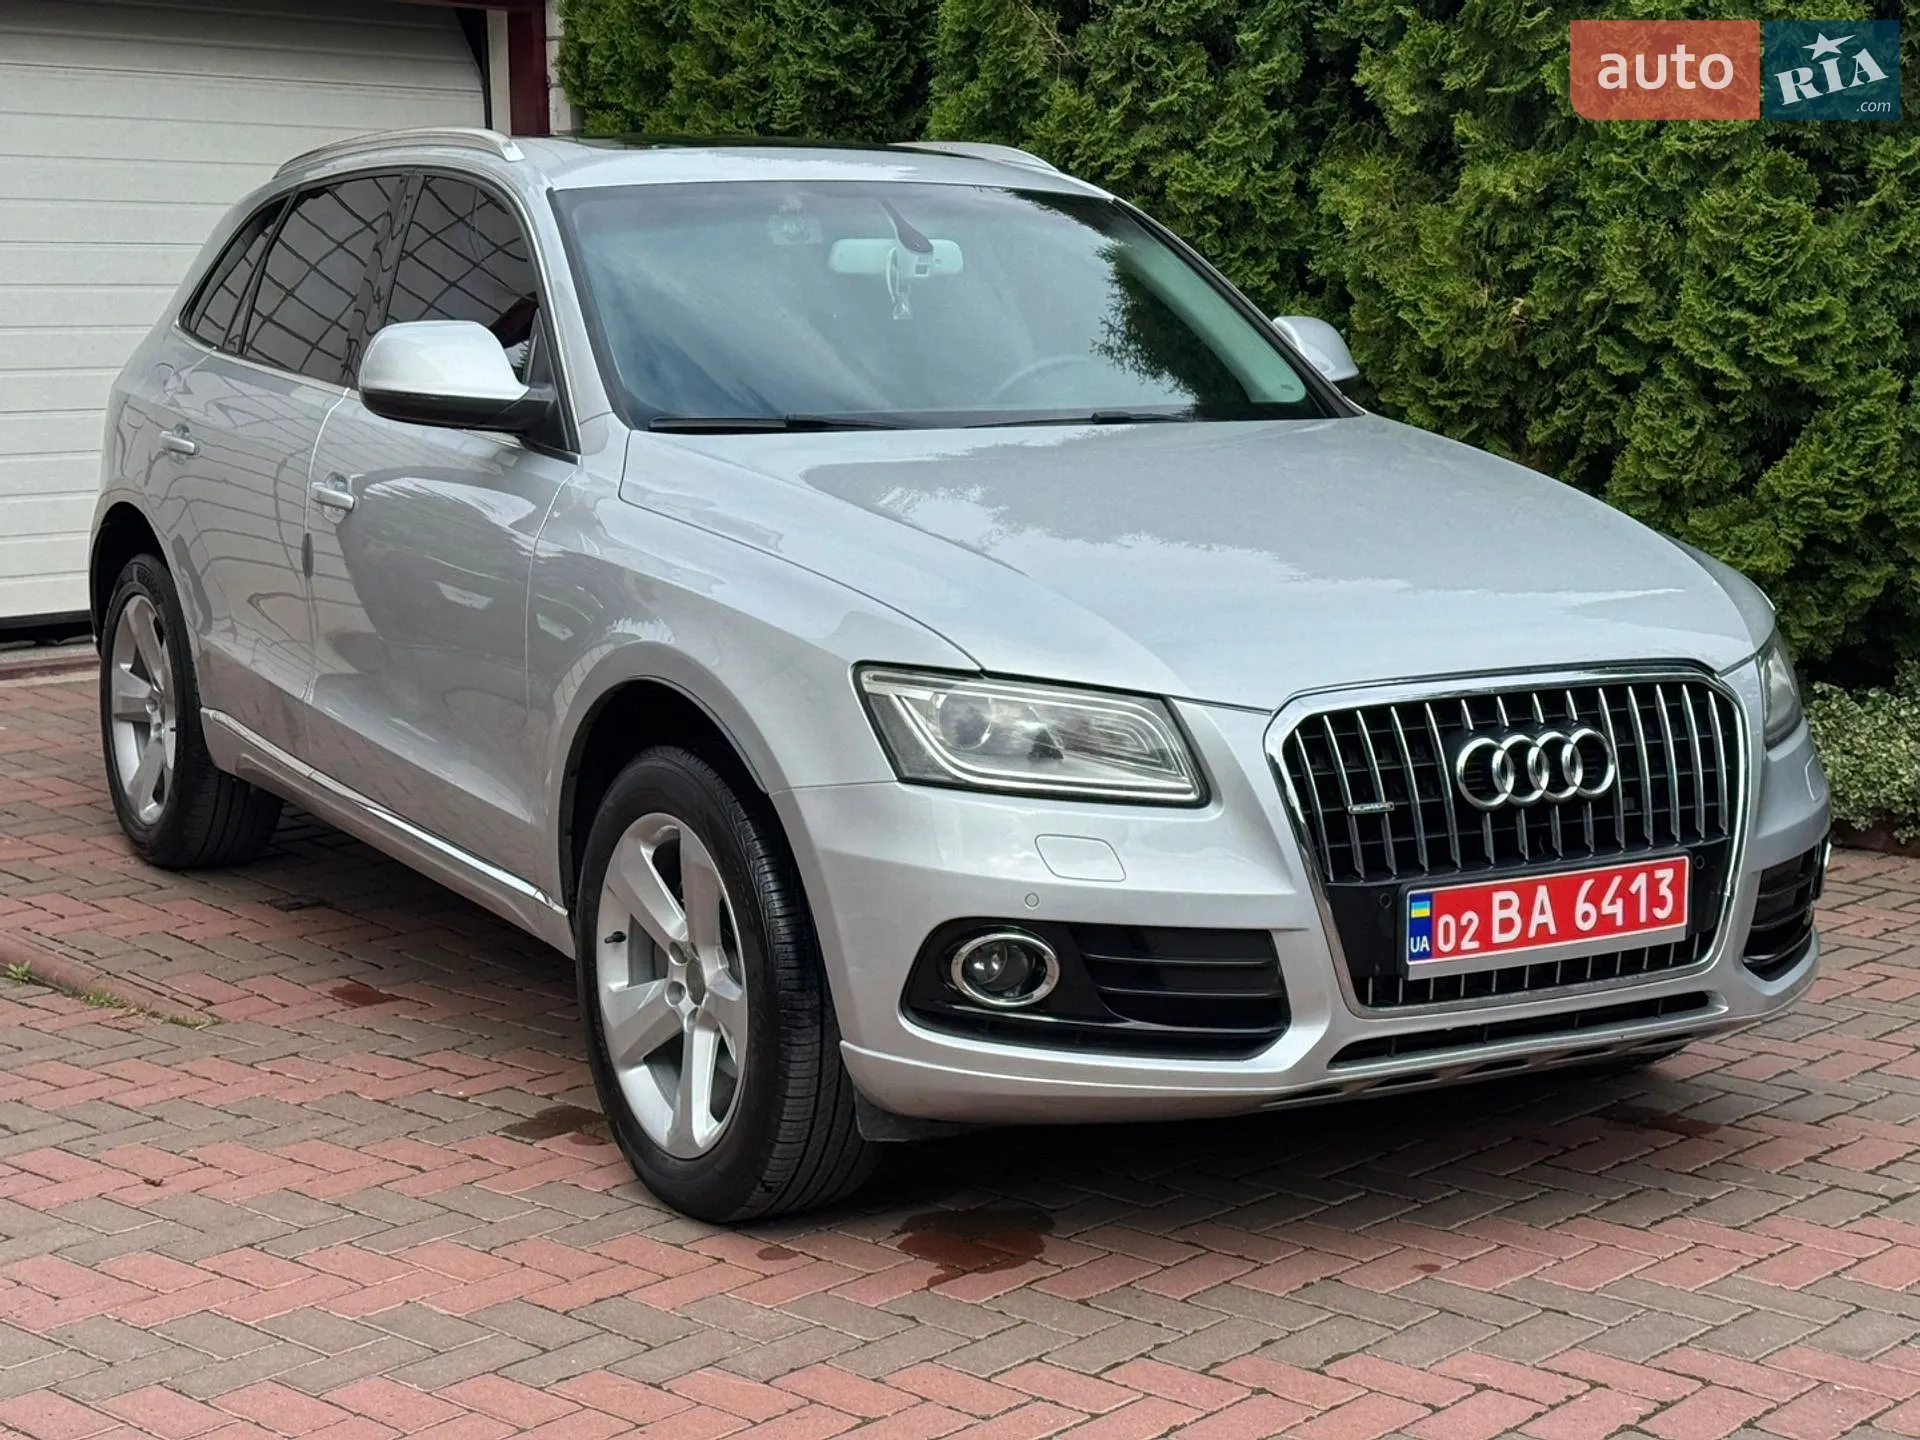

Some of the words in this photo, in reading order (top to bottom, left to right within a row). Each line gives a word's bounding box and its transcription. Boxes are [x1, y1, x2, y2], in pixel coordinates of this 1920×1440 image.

[1437, 911, 1480, 953] 02
[1491, 885, 1557, 944] BA
[1574, 868, 1674, 932] 6413
[1410, 935, 1430, 953] UA
